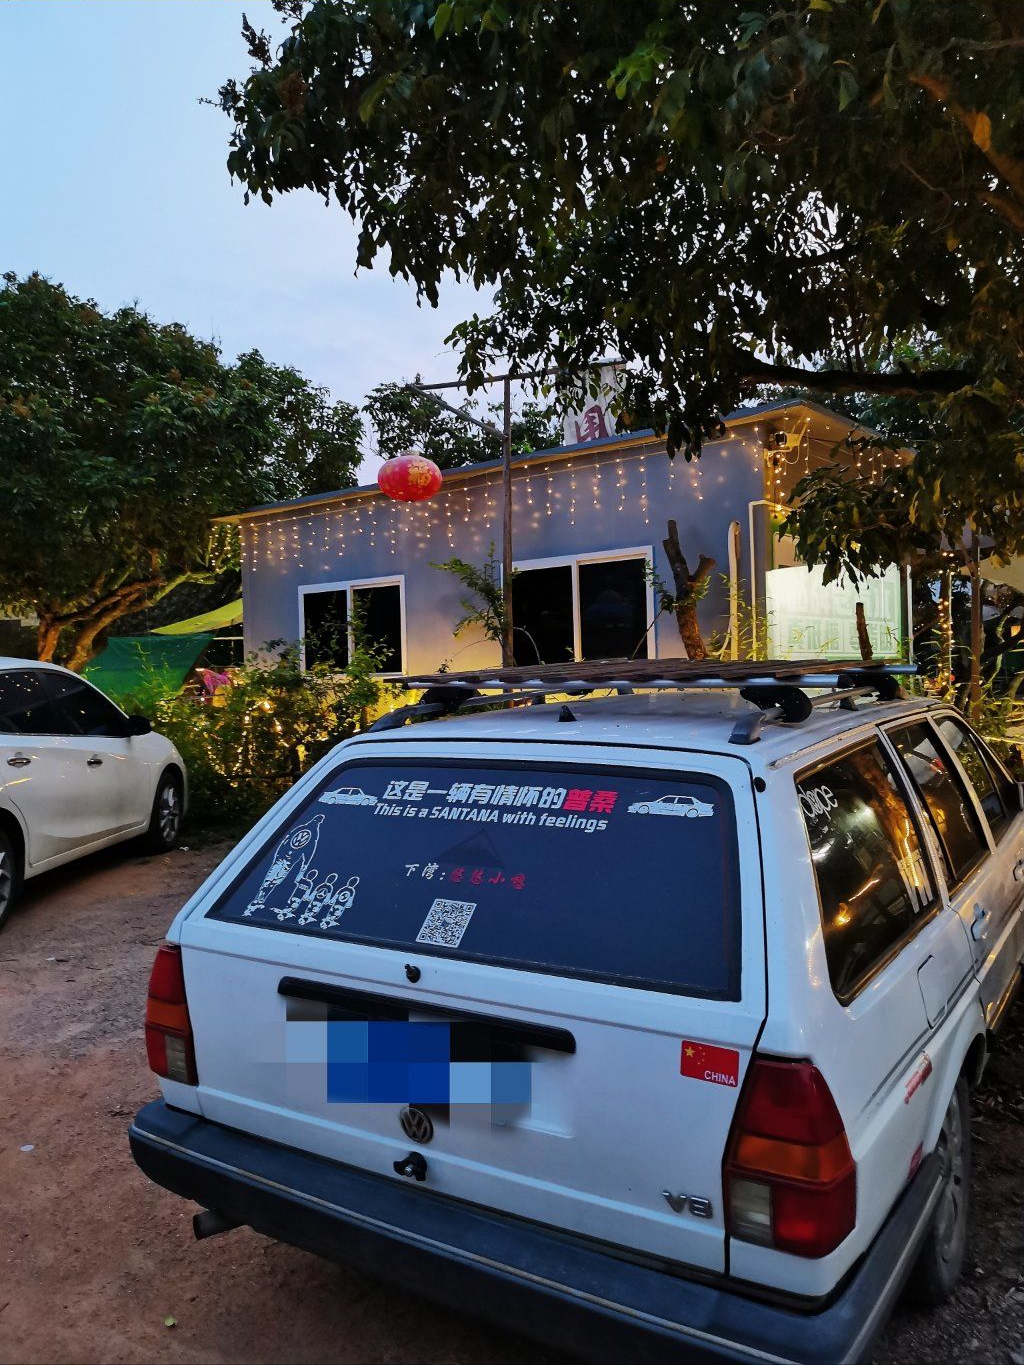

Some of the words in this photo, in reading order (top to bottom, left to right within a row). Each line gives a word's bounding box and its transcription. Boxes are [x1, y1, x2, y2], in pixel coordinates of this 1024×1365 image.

[382, 780, 619, 814] 这是一辆有情怀的普桑
[374, 802, 403, 816] This
[403, 804, 419, 817] is
[418, 808, 430, 818] a
[429, 806, 500, 823] SANTANA
[502, 811, 537, 826] with
[538, 812, 609, 833] feelings
[703, 1070, 736, 1086] CHINA
